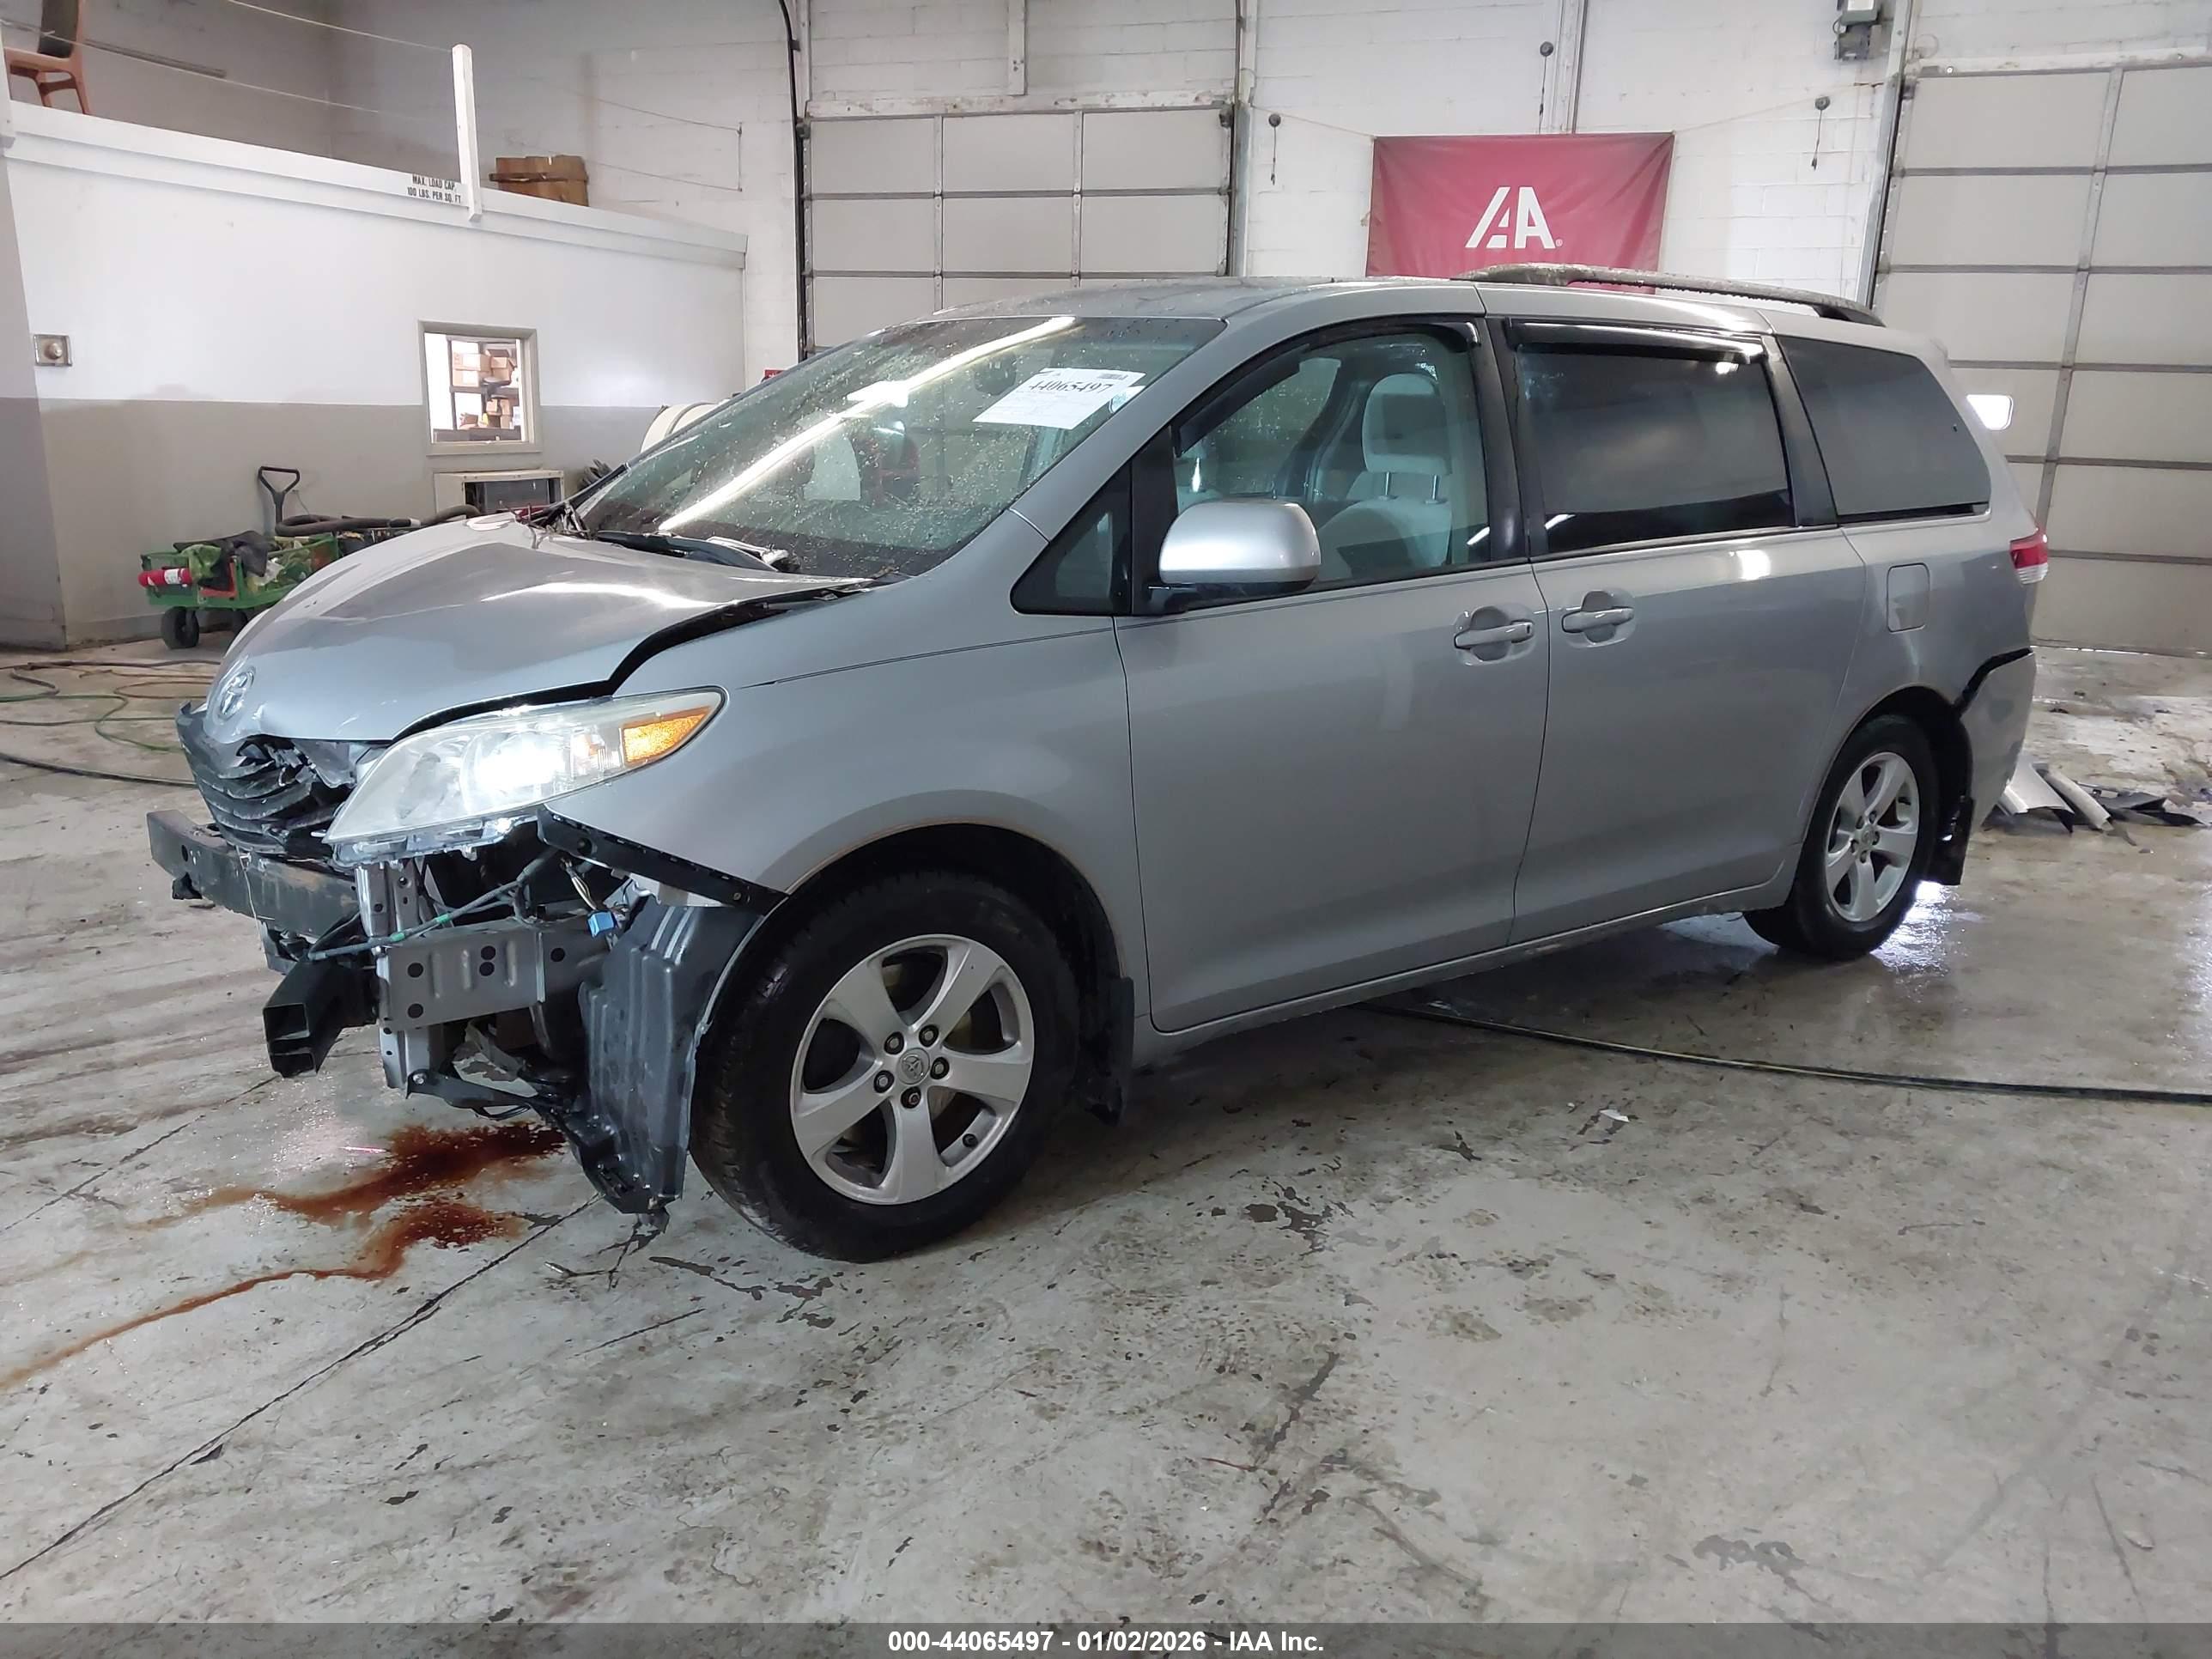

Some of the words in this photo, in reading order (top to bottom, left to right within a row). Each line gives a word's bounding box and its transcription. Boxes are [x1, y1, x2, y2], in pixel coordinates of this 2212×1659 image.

[429, 178, 443, 189] LOAD
[407, 186, 417, 197] 100
[419, 188, 431, 198] LBS.
[433, 191, 443, 201] PER
[1030, 380, 1114, 393] 44065497
